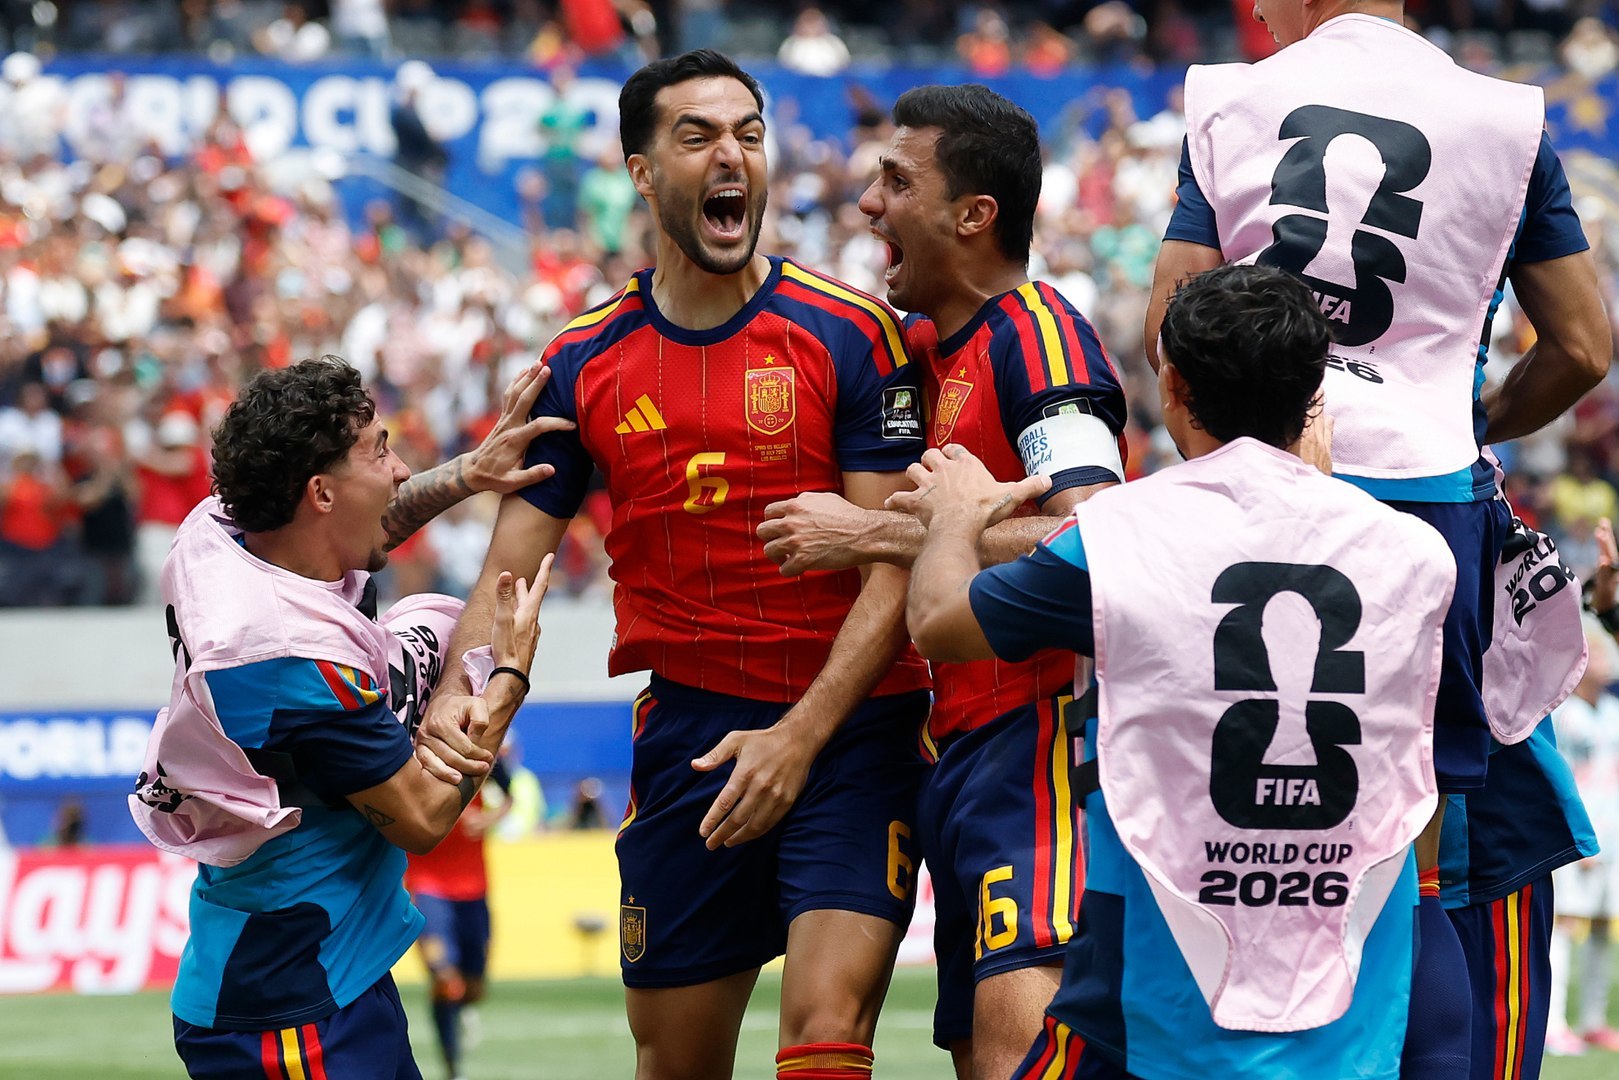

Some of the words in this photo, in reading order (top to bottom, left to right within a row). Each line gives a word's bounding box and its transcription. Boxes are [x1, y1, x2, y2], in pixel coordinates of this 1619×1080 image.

[1312, 291, 1351, 325] FA
[683, 451, 730, 514] 6
[0, 717, 152, 780] ORLD
[1255, 777, 1322, 806] FIFA
[886, 819, 913, 901] 6
[1204, 841, 1299, 865] WORLD
[1303, 842, 1354, 865] CUP
[1198, 869, 1350, 908] 2026
